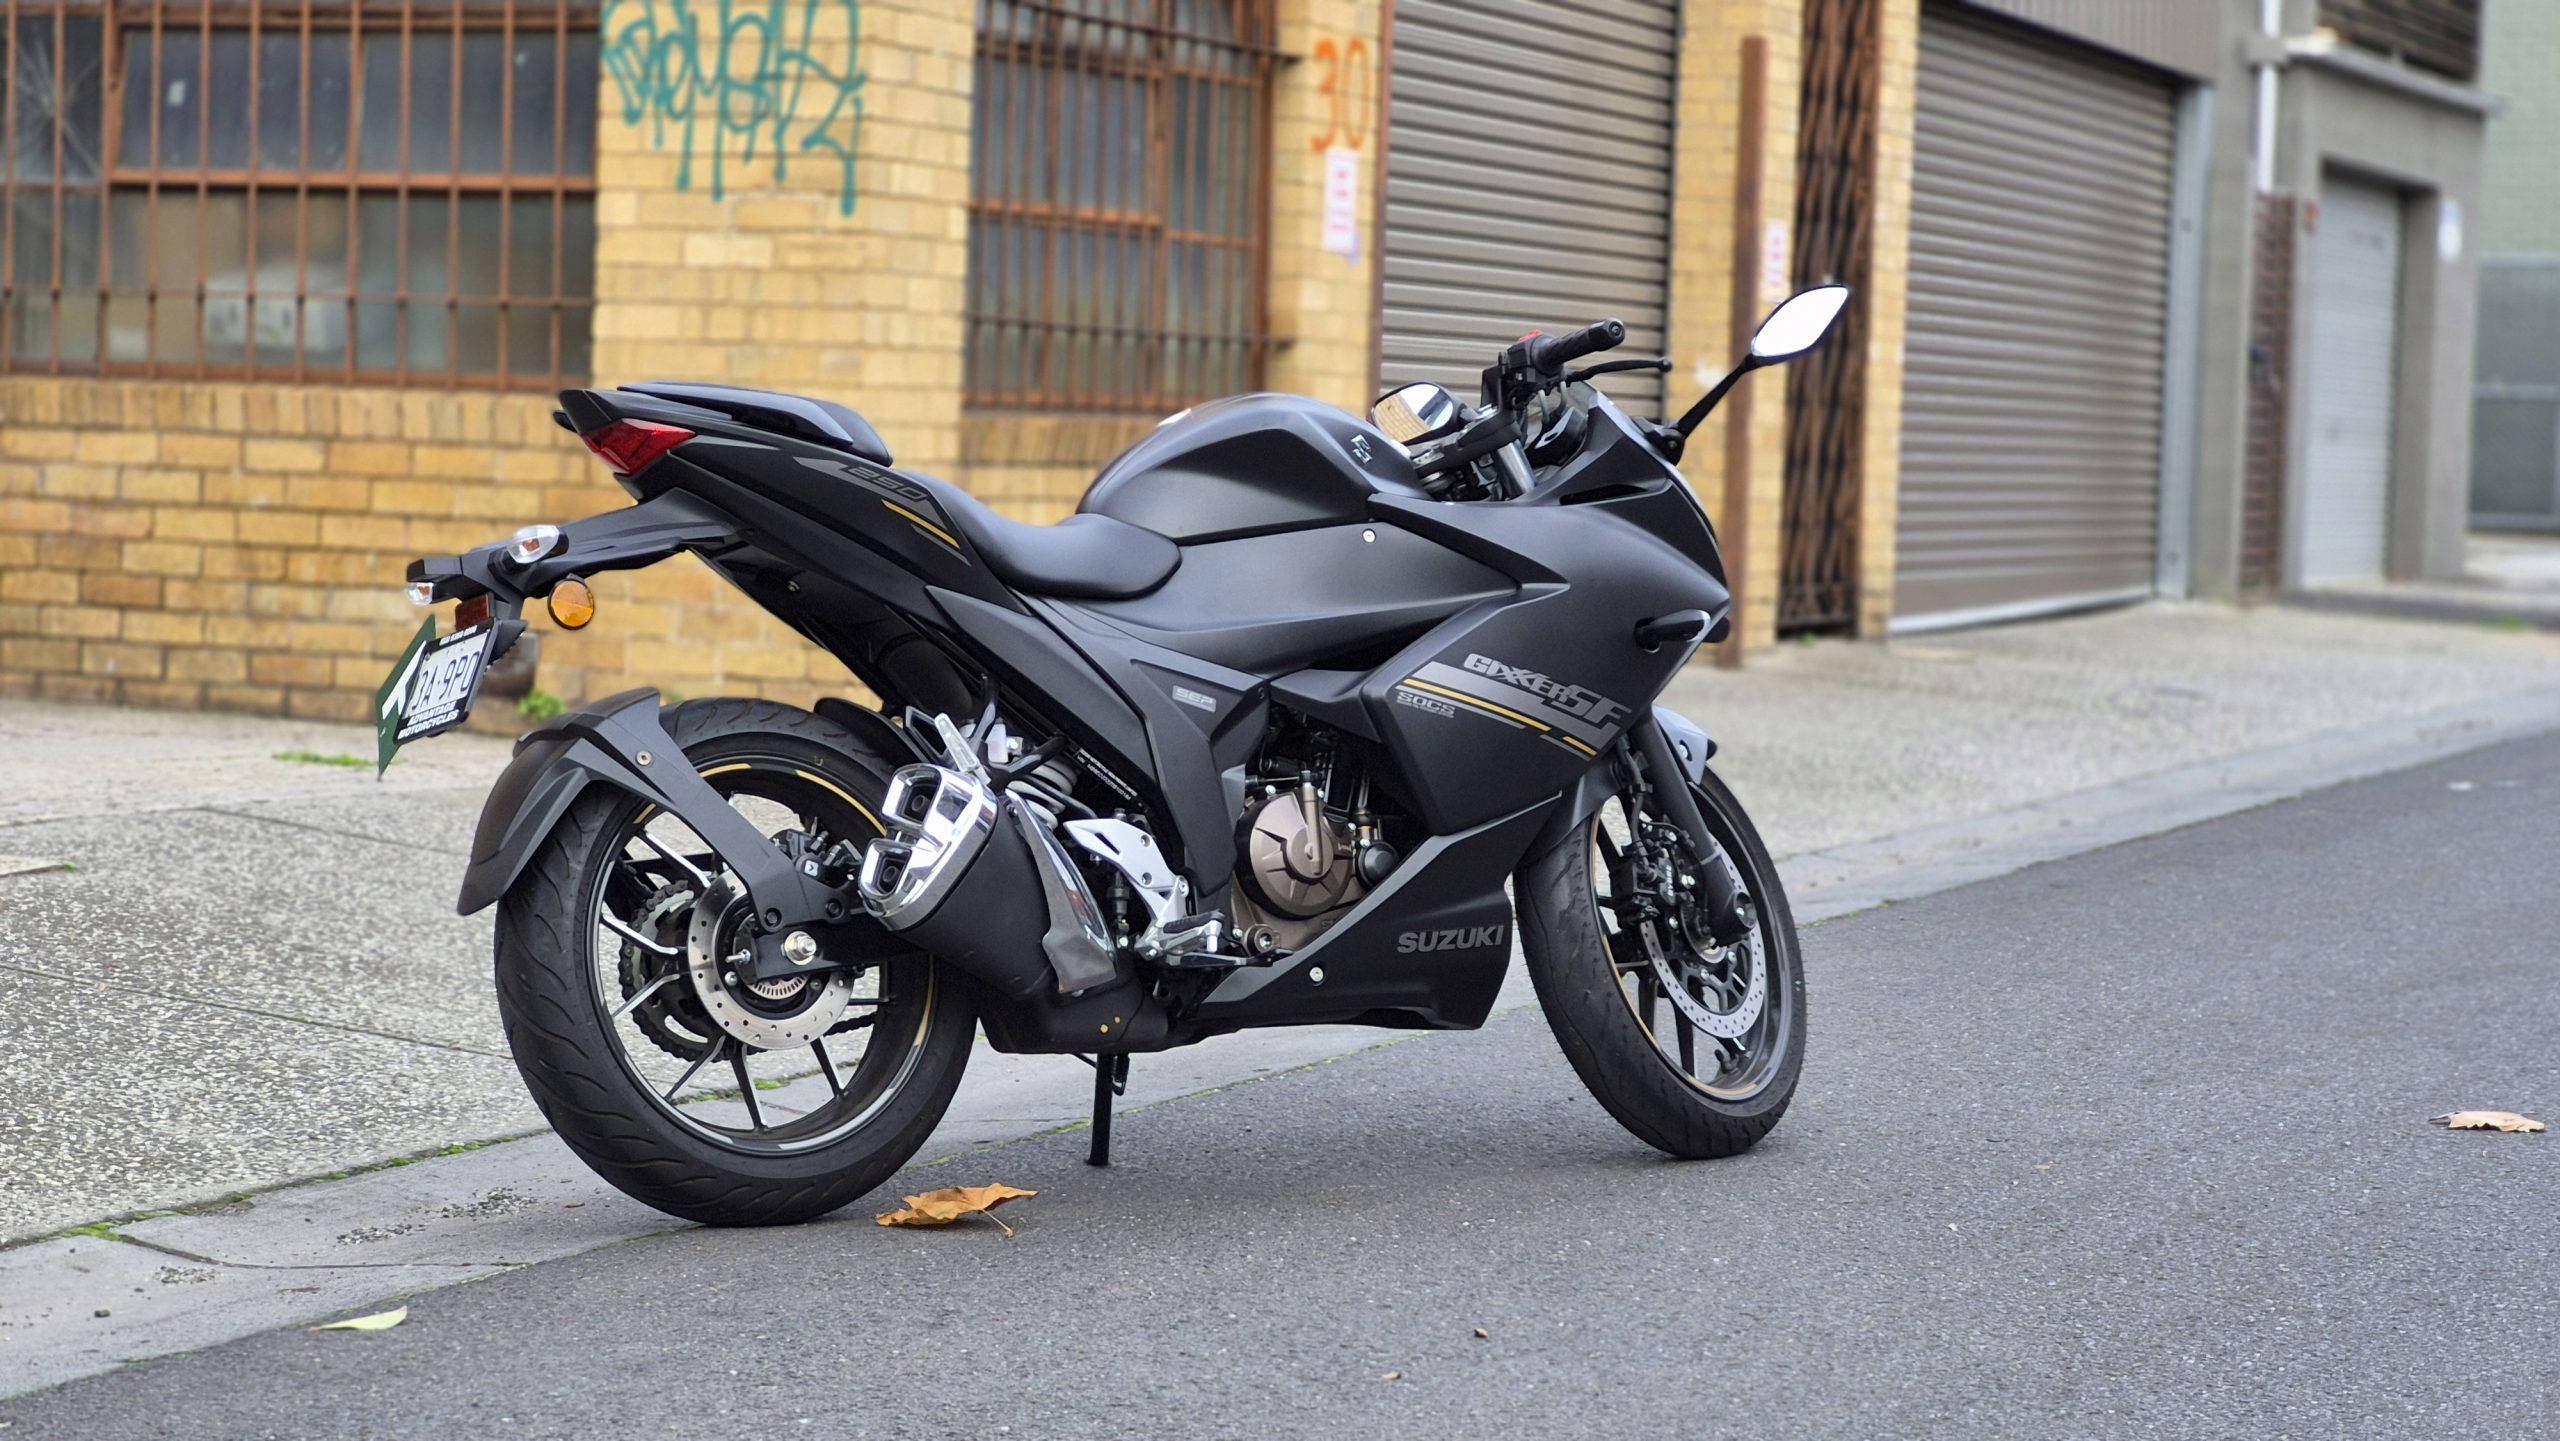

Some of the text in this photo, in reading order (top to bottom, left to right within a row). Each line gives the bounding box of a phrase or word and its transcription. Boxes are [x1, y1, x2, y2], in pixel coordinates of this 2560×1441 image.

[1311, 37, 1370, 154] 30
[848, 467, 928, 500] 250
[1175, 687, 1213, 705] SEP
[1397, 692, 1456, 714] SOCS
[1464, 653, 1632, 724] GIXXER SF
[1397, 925, 1505, 954] SUZUKI
